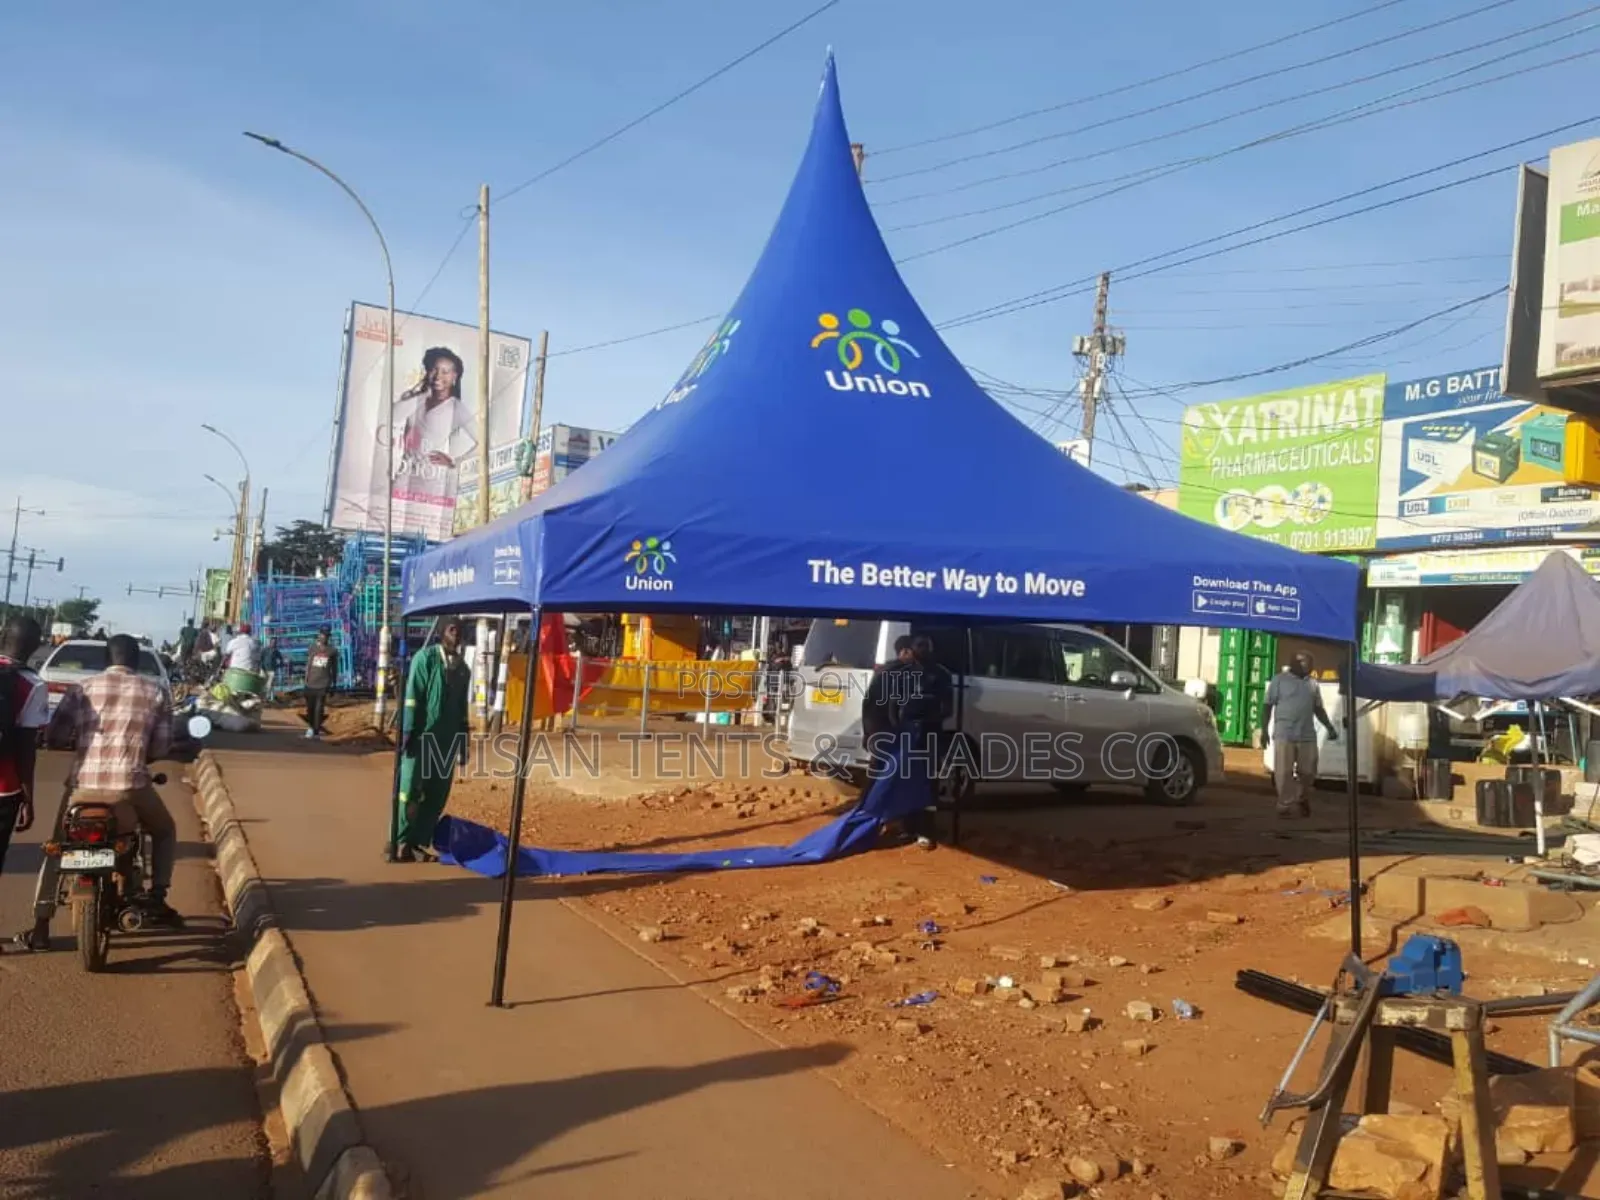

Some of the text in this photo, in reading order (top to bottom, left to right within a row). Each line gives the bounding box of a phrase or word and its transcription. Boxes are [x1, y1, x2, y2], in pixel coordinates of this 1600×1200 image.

[825, 370, 931, 398] Union
[1405, 380, 1440, 401] M.G
[1211, 438, 1375, 480] PHARMACEUTICALS
[625, 576, 673, 592] Union
[808, 560, 1086, 598] The Better Way to Move
[1193, 575, 1297, 596] Download The App
